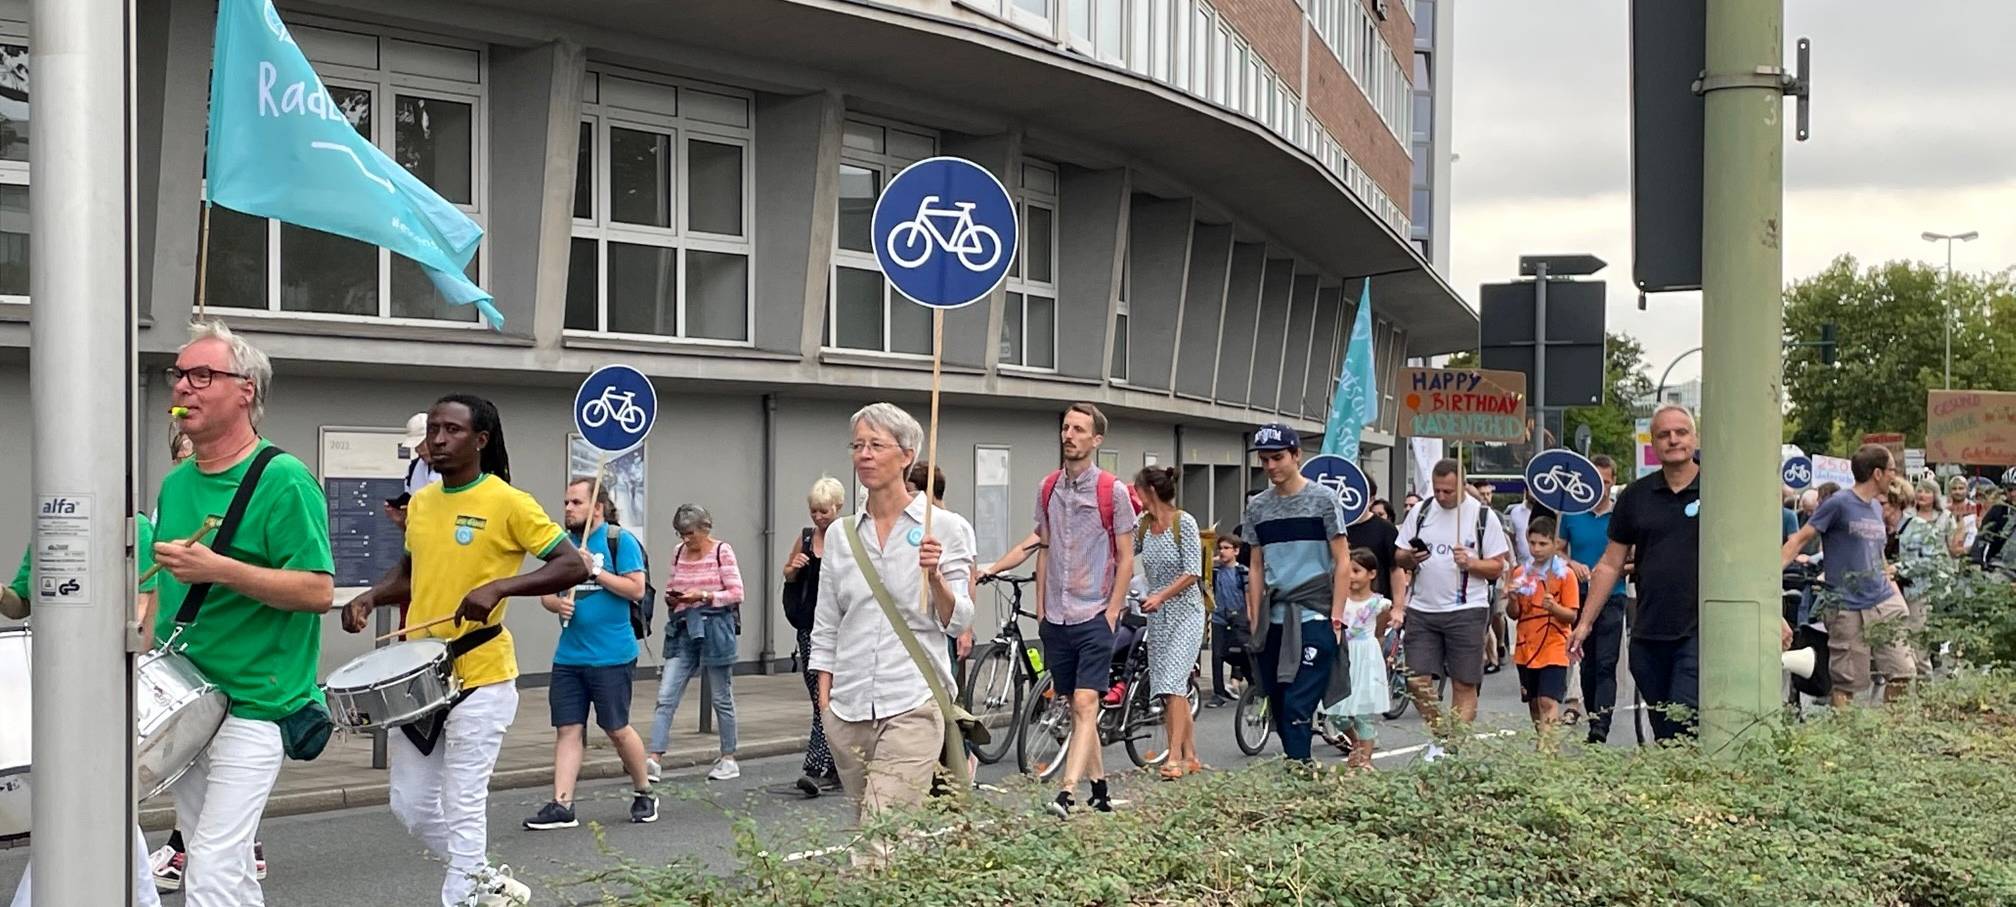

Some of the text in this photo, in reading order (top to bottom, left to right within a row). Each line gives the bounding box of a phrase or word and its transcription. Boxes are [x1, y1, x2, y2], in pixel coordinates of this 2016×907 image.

[1413, 371, 1481, 391] HAPPY
[1431, 392, 1520, 414] BIRTHDAY
[43, 498, 75, 513] alfa
